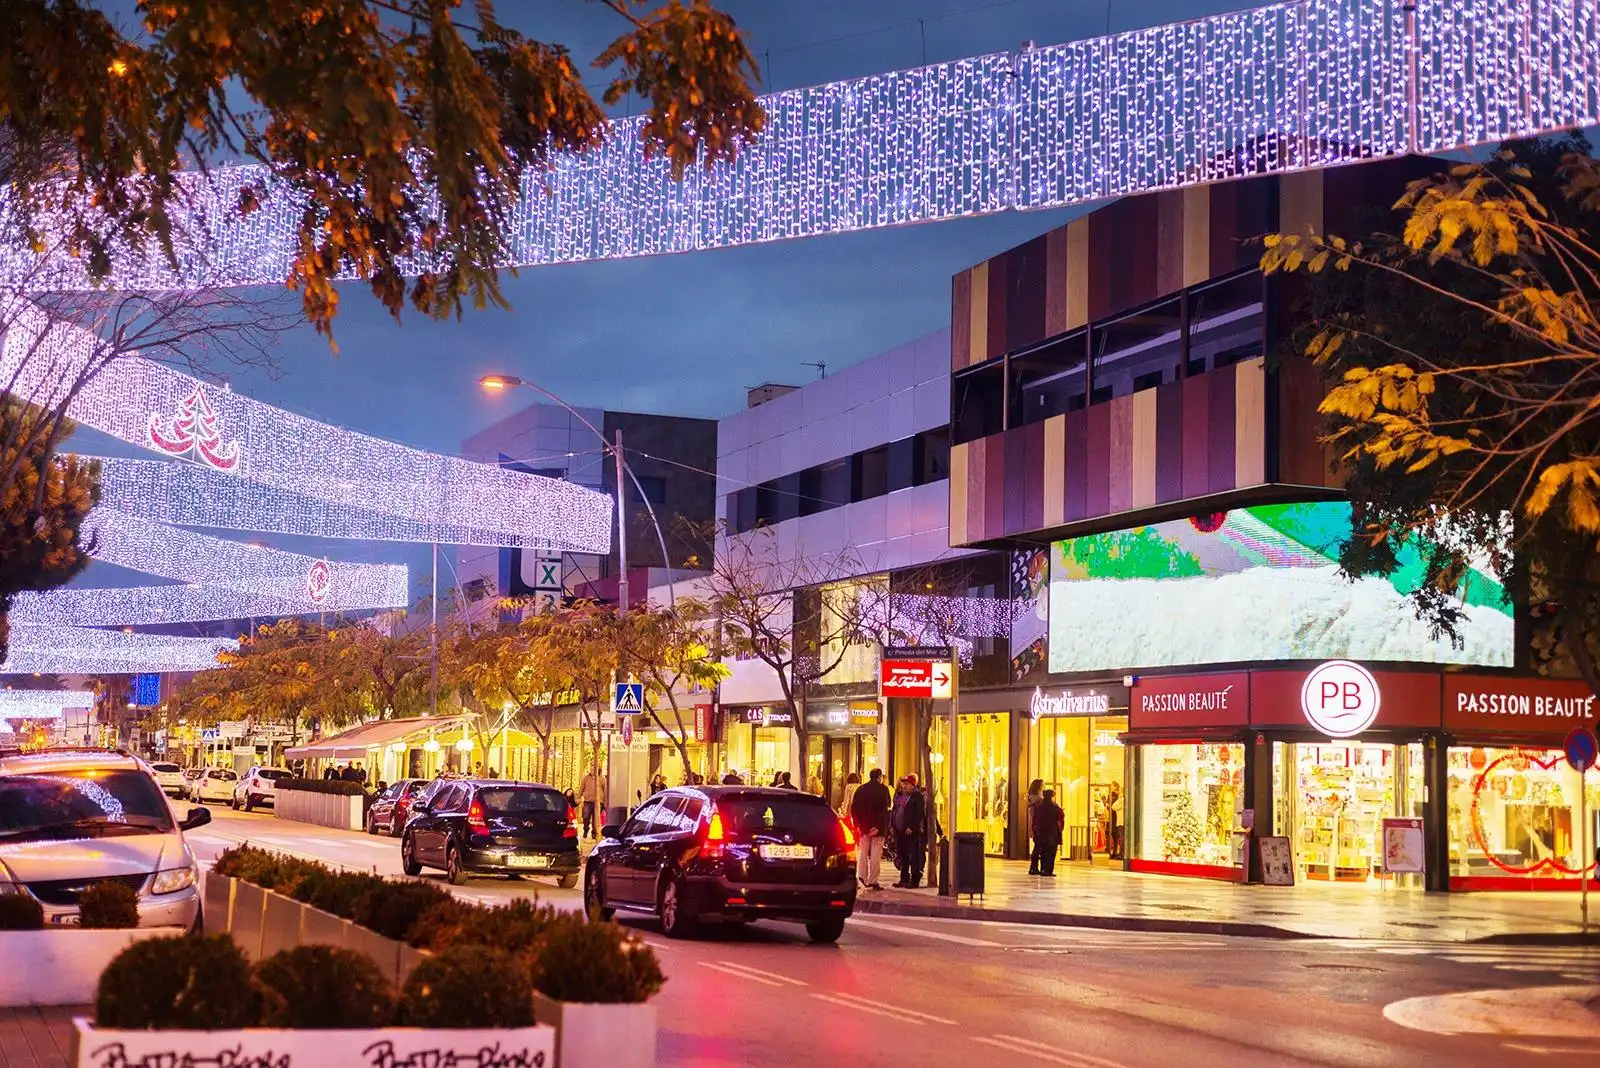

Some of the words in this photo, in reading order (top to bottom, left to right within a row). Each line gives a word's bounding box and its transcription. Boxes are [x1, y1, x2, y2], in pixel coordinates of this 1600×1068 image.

[1142, 693, 1186, 712] PASSION
[1189, 685, 1233, 711] BEAUTÉ
[1321, 681, 1362, 710] PB
[1457, 692, 1530, 715] PASSION
[1535, 694, 1597, 718] BEAUTÉ
